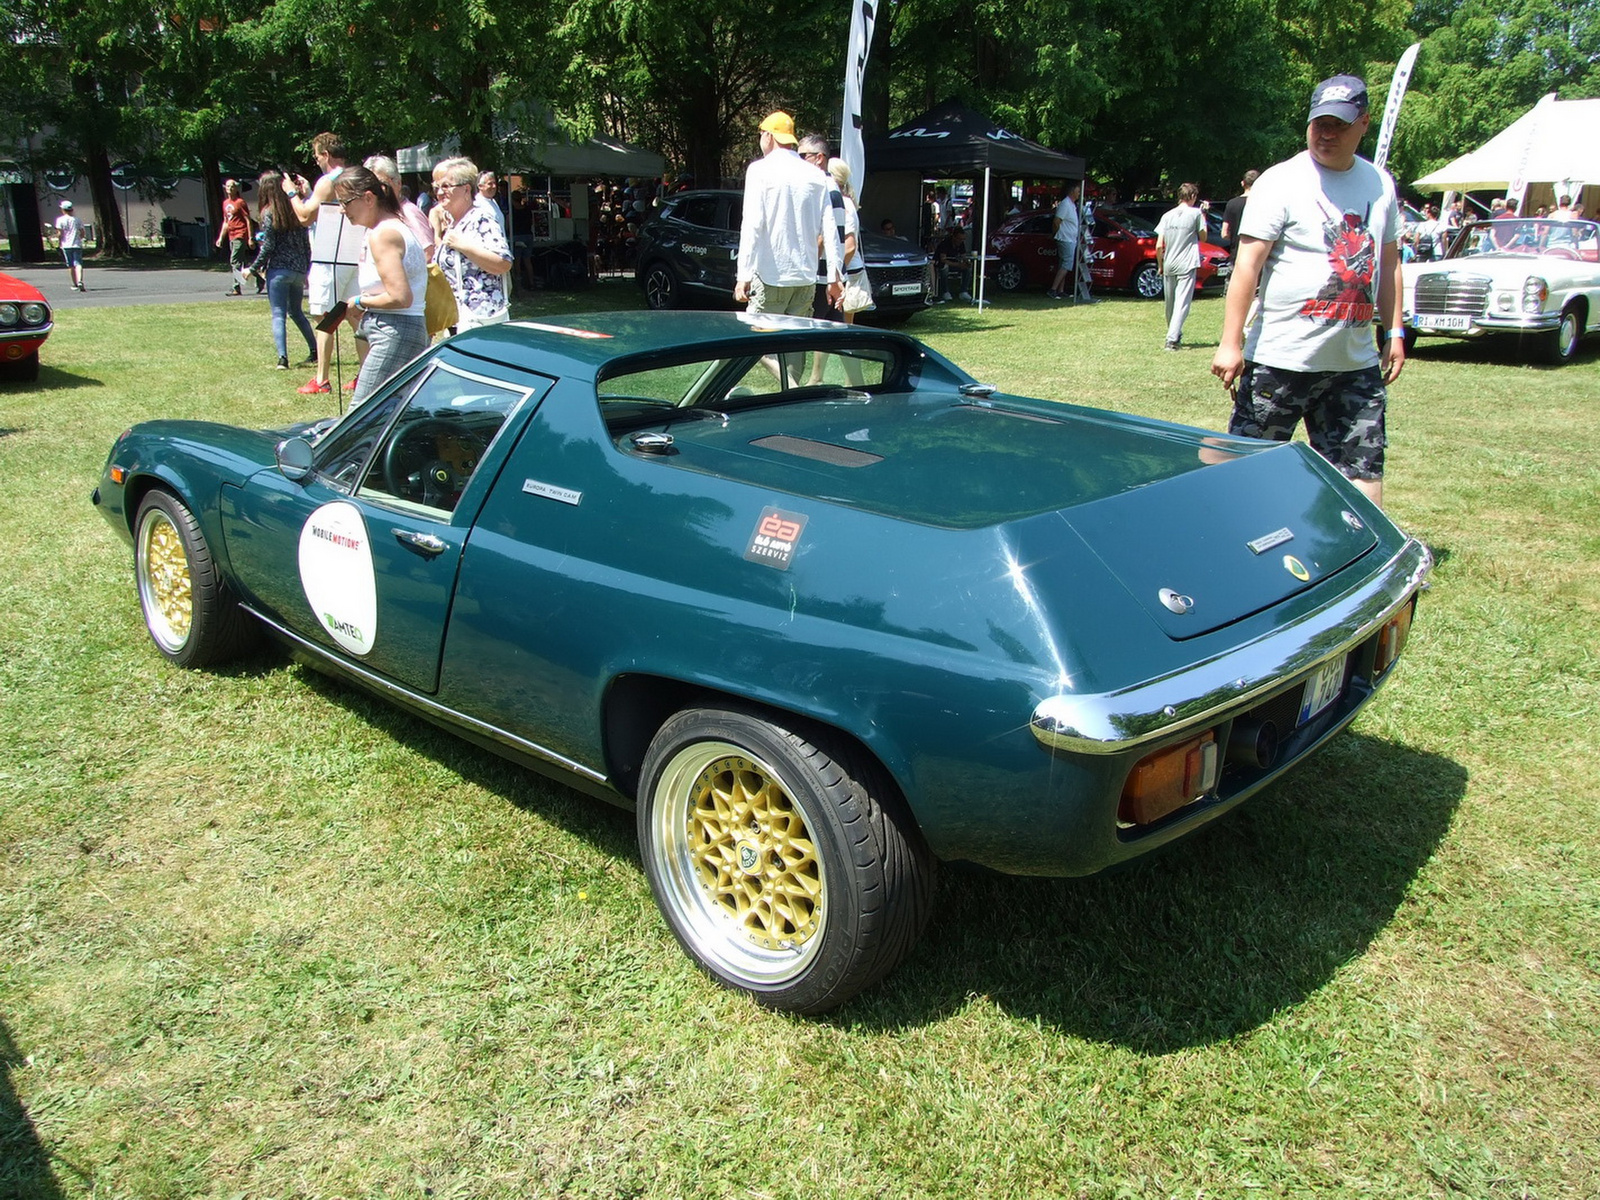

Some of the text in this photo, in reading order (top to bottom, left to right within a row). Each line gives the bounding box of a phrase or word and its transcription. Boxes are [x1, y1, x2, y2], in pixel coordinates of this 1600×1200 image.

[681, 243, 708, 256] Sportage
[1037, 246, 1058, 256] Ceed
[1299, 299, 1374, 322] DEADPOO
[526, 483, 546, 492] EUROPA
[751, 545, 789, 561] SZERVIZ
